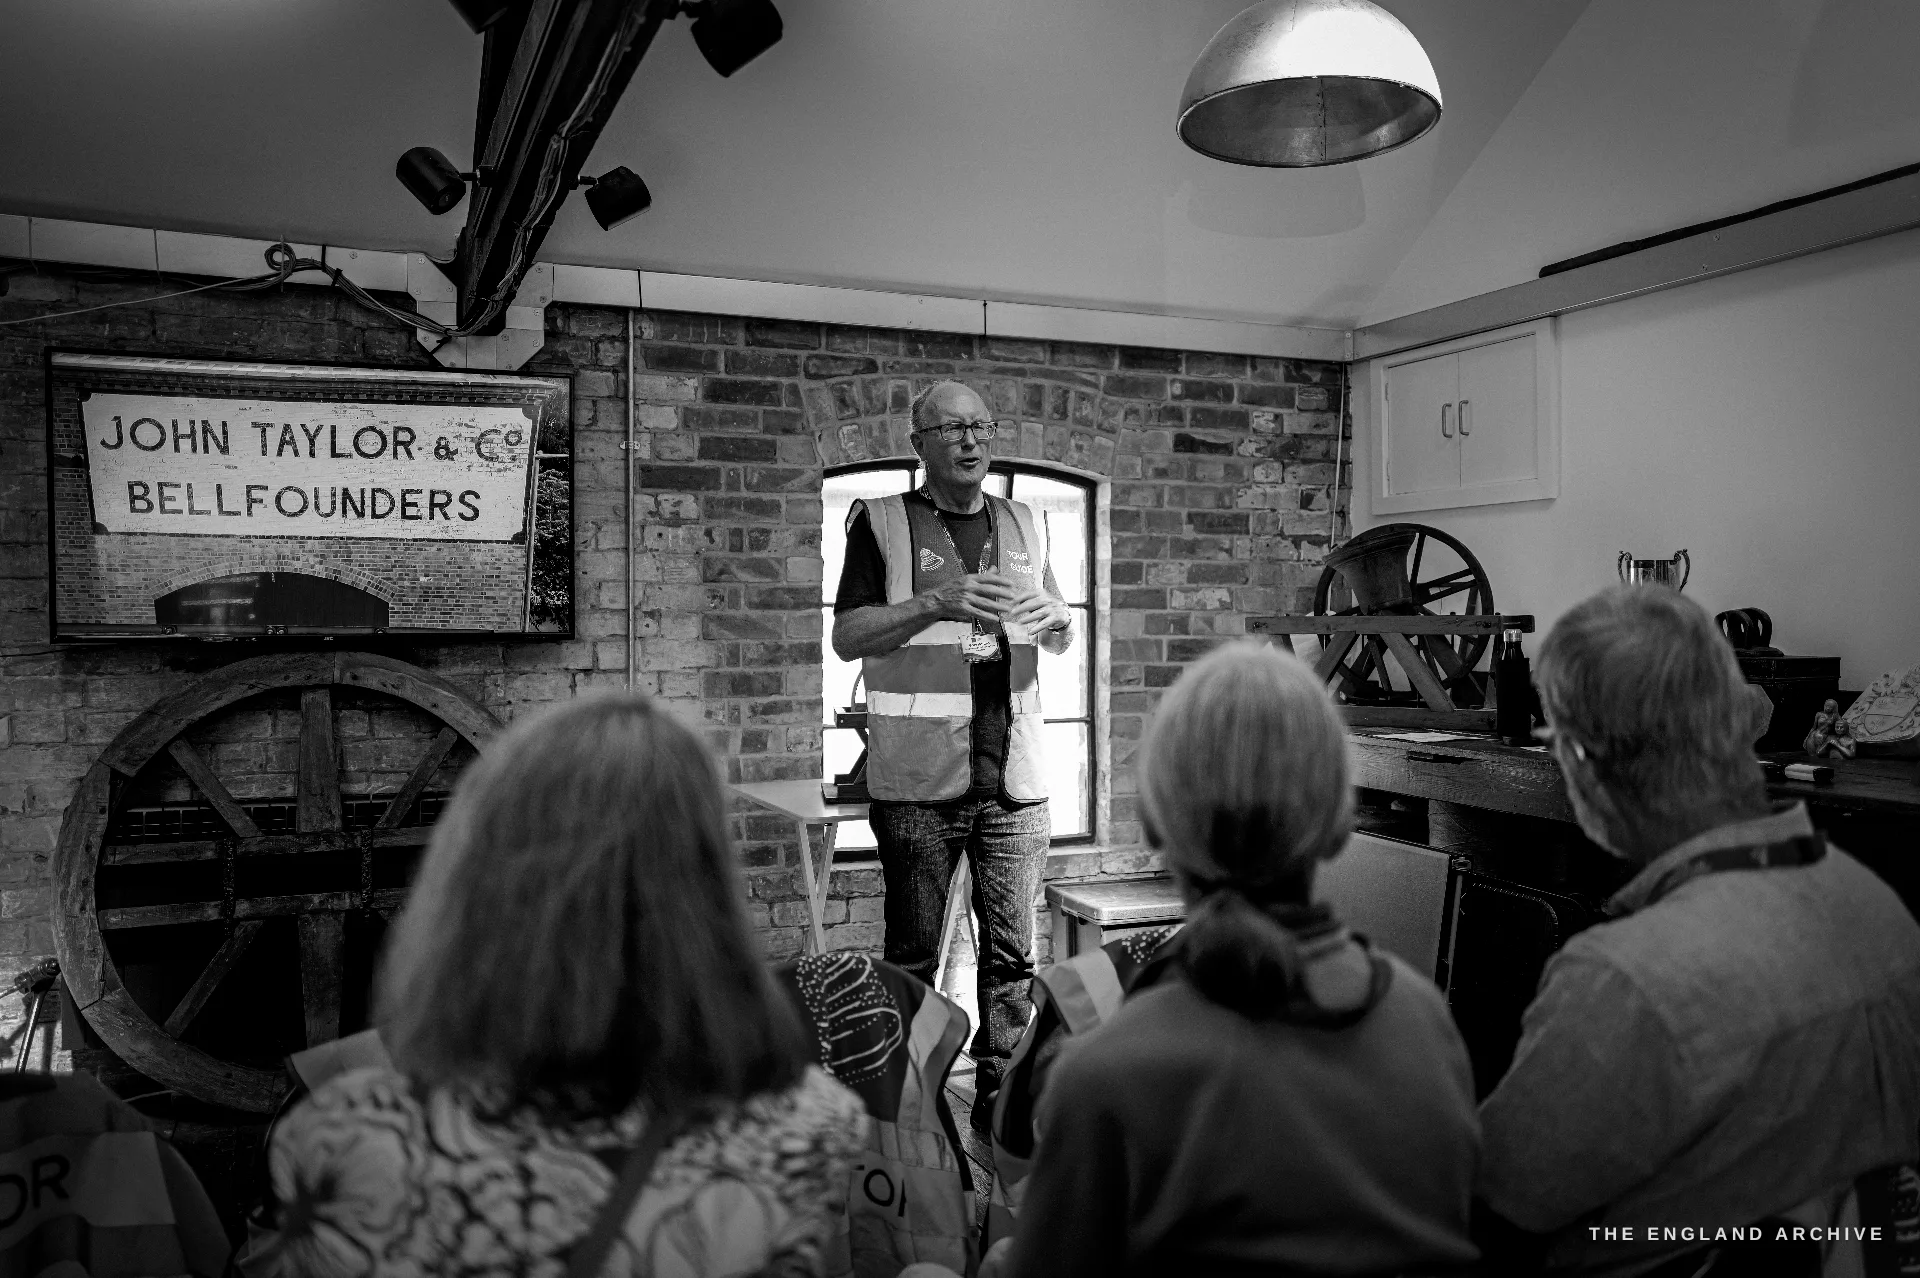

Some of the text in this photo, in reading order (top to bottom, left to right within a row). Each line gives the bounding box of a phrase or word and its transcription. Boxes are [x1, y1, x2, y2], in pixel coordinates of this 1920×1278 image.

[100, 415, 230, 456] JOHN
[251, 421, 416, 460] TAYLOR
[433, 436, 458, 461] &
[127, 480, 481, 522] BELLFOUNDERS
[1006, 549, 1028, 561] TOUR
